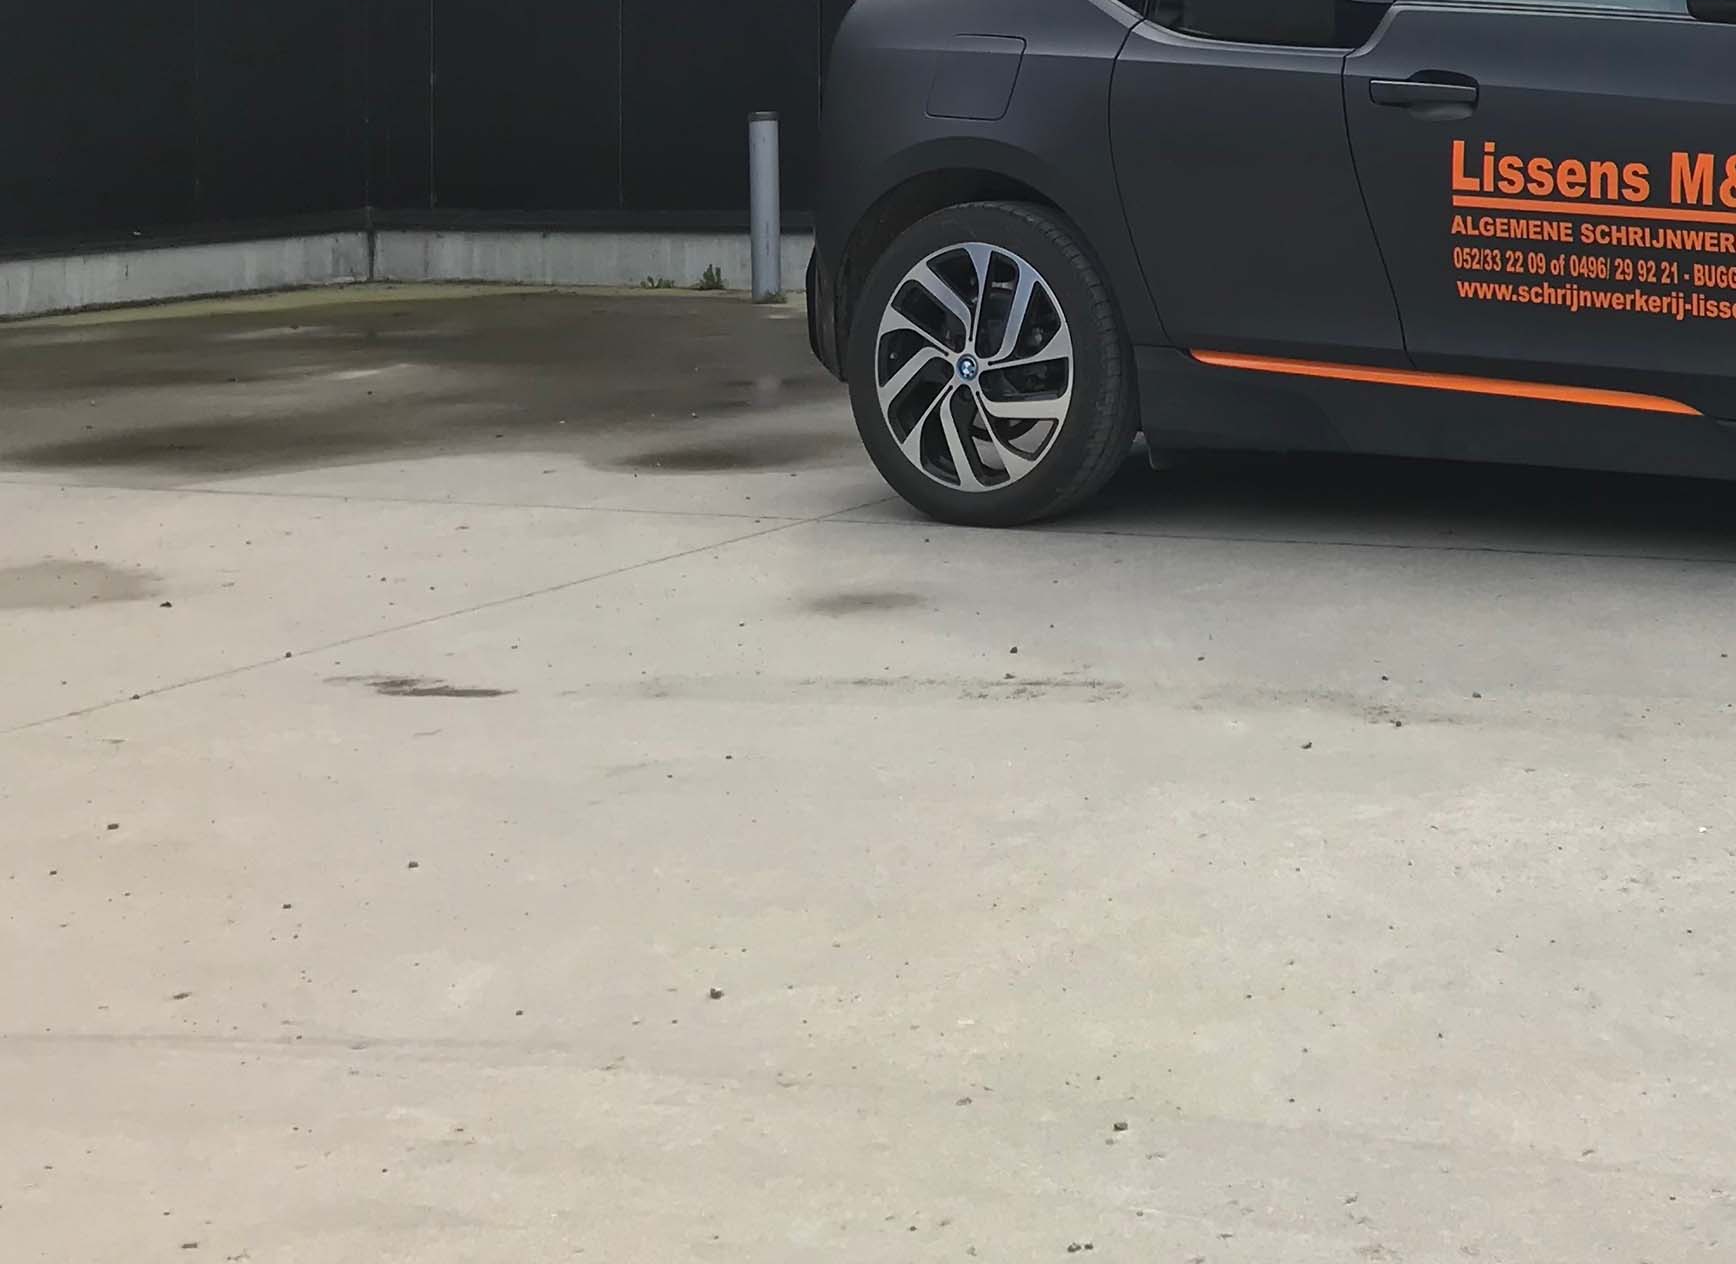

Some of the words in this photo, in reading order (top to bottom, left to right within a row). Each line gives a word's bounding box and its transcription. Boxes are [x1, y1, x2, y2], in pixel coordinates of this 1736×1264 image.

[1452, 140, 1650, 202] Lissens
[1451, 215, 1573, 242] ALGEMENE
[1453, 247, 1501, 271] 052/33
[1506, 250, 1524, 273] 22
[1528, 251, 1546, 275] 09
[1551, 254, 1566, 276] of
[1570, 255, 1610, 280] 0496/
[1615, 258, 1633, 281] 29
[1638, 260, 1657, 283] 92
[1661, 261, 1679, 285] 21
